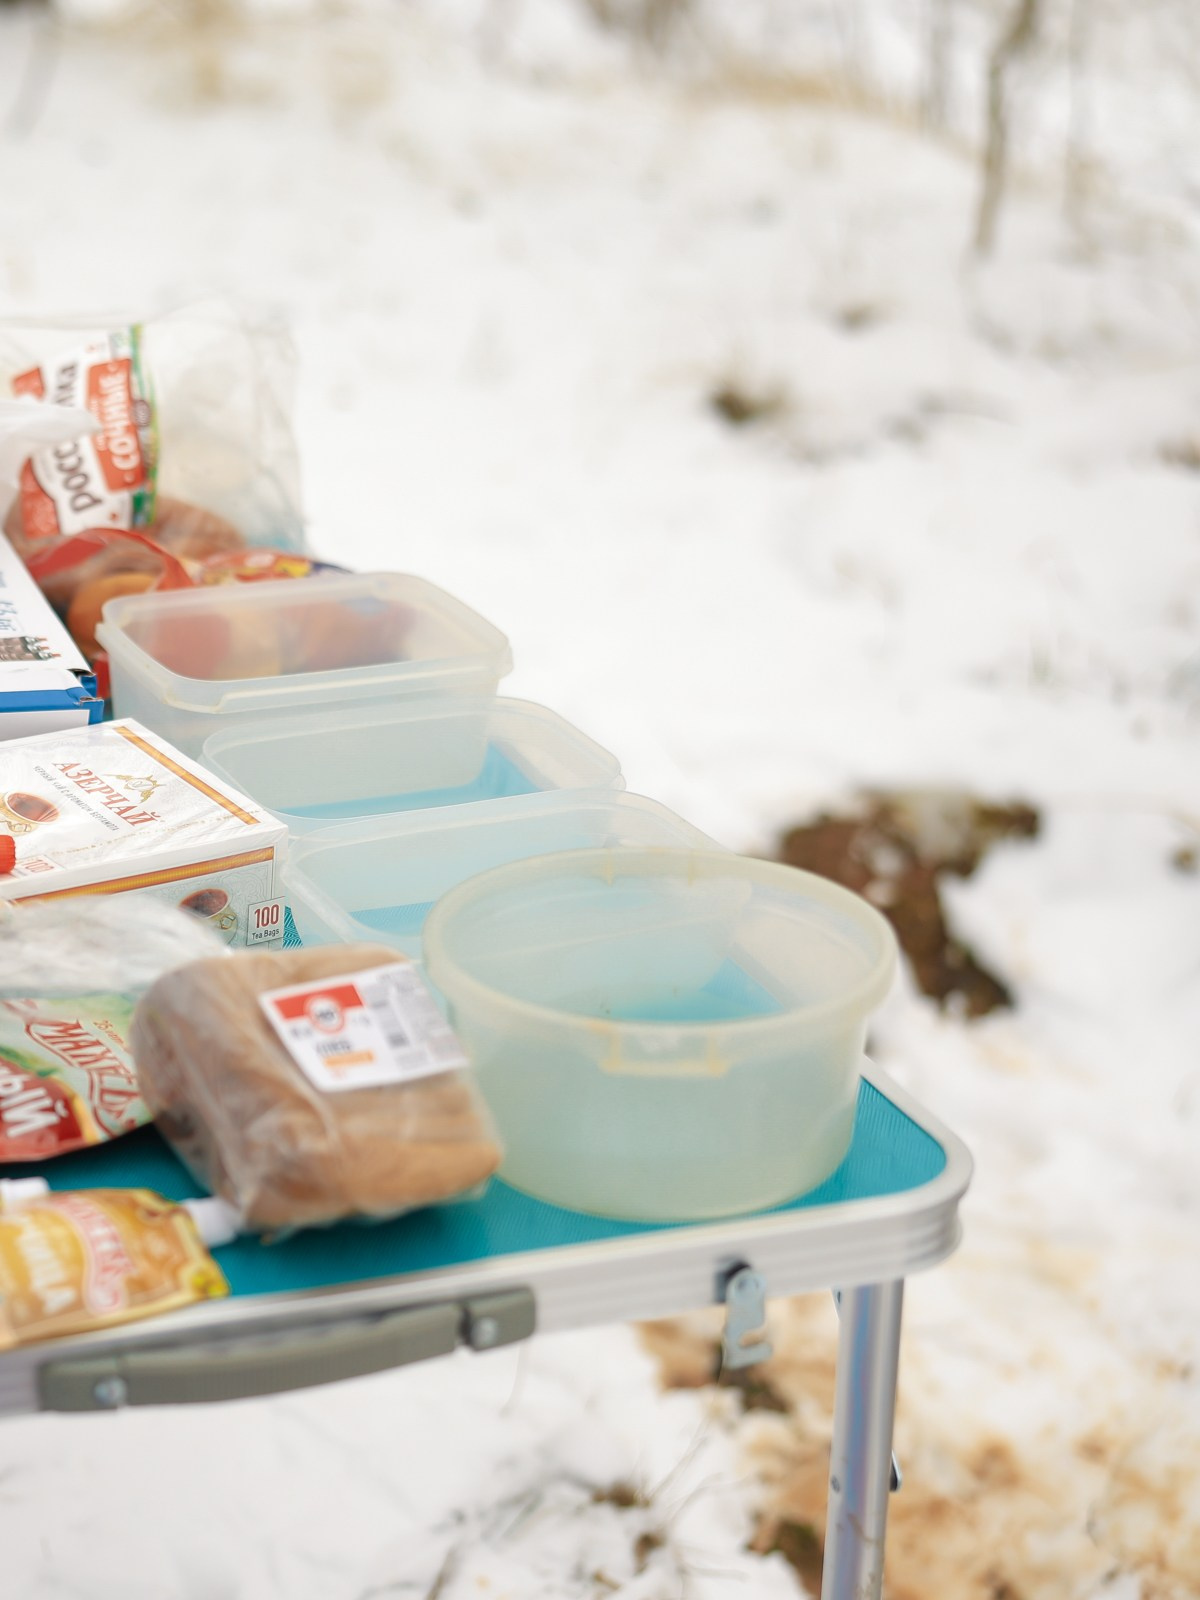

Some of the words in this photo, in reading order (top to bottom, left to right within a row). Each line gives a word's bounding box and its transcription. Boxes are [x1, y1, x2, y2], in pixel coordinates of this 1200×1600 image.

[52, 761, 162, 827] АЗЕРЧАЙ
[254, 904, 280, 928] 100
[251, 930, 263, 941] Tea
[263, 926, 280, 940] Bags
